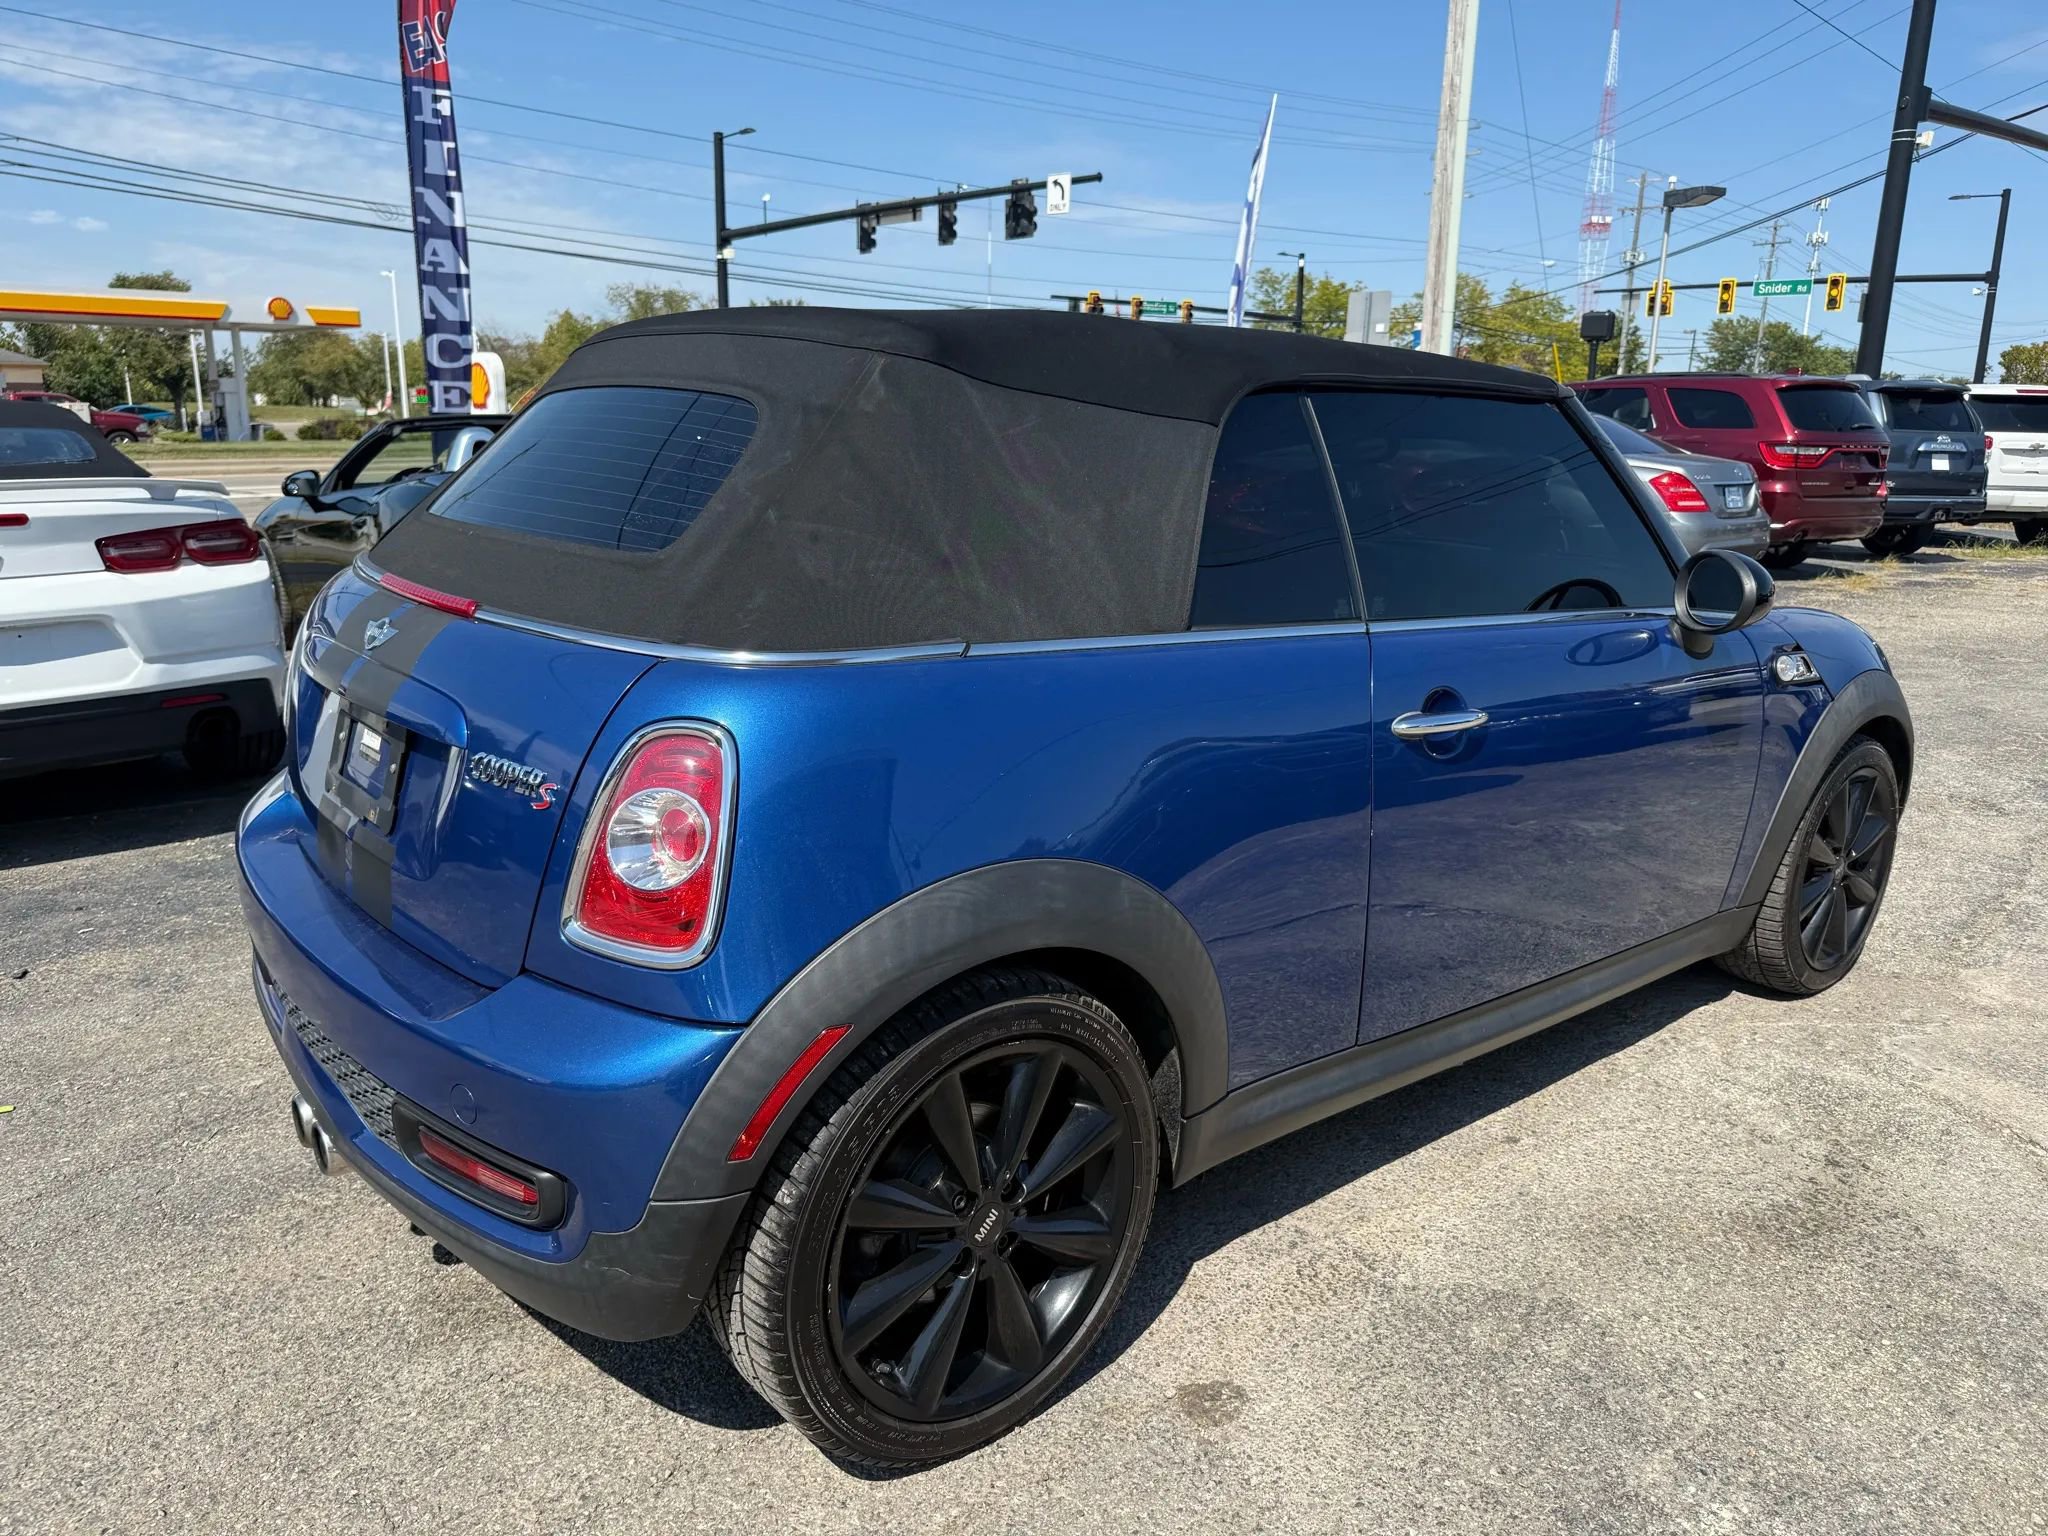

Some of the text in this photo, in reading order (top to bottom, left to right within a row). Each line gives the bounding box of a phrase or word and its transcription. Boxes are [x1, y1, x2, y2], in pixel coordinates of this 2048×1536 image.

[411, 85, 473, 413] FINANCE
[1758, 283, 1807, 294] Snider Rd
[470, 752, 557, 809] COOPER S
[974, 1208, 999, 1242] MINI
